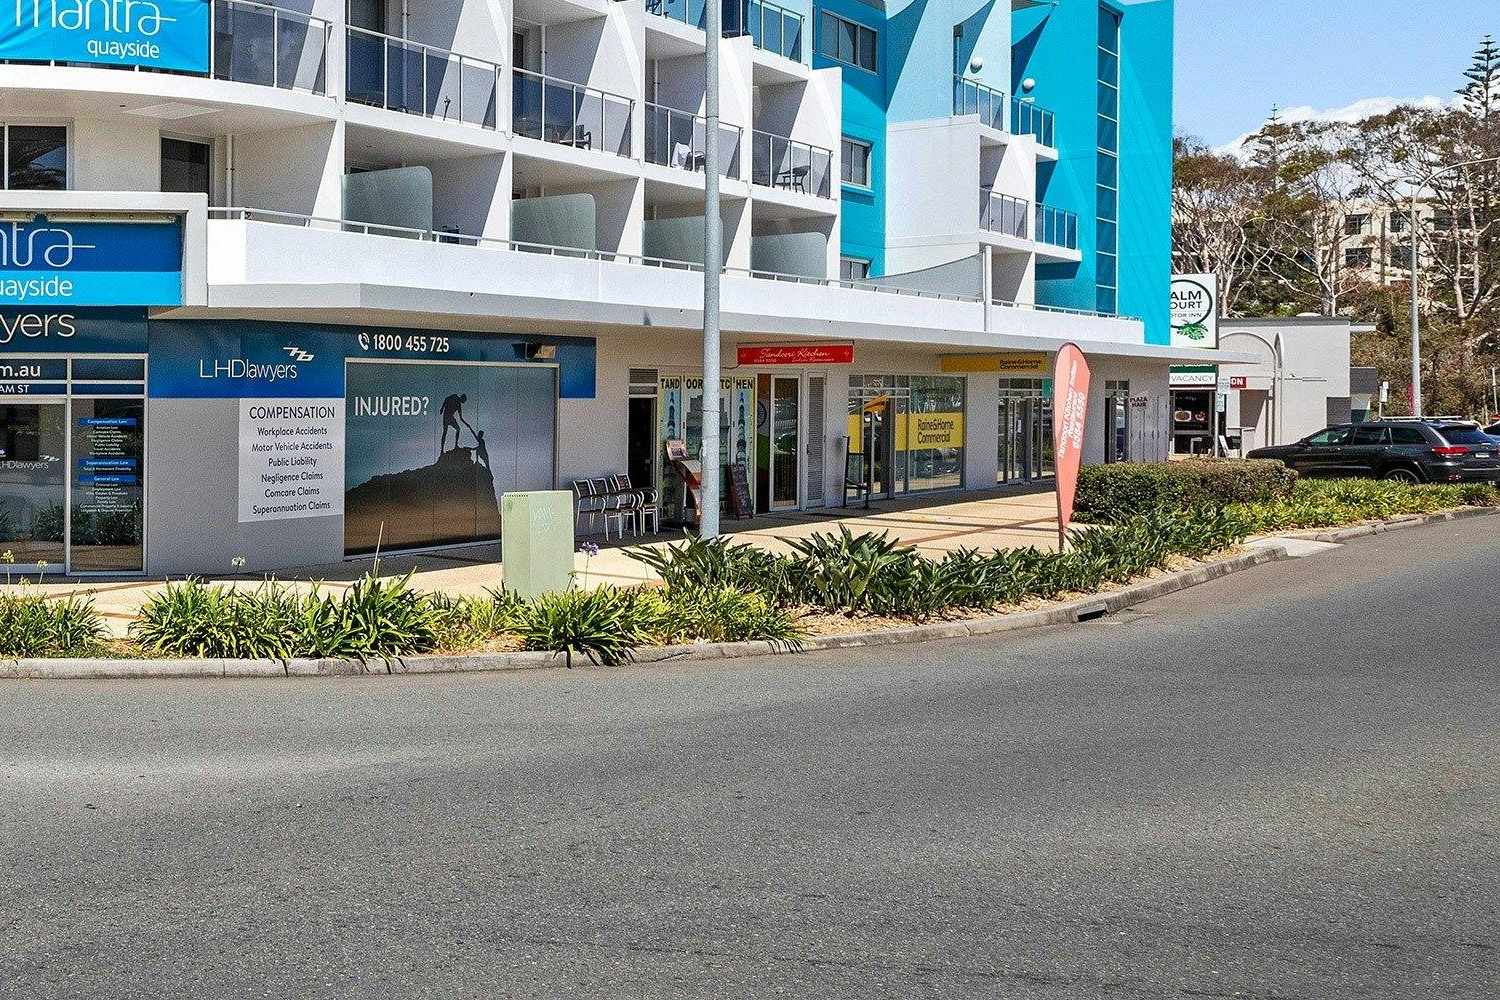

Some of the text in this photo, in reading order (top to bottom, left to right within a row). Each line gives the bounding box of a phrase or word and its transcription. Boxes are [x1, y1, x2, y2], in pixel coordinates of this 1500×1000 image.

[86, 38, 160, 60] quayside
[1170, 290, 1202, 300] ALM
[1170, 301, 1202, 310] OURT
[373, 334, 450, 353] 1800 455 725
[797, 348, 830, 358] Kitchen
[200, 359, 298, 382] LHDlawyers
[16, 384, 30, 394] ST
[354, 396, 429, 416] INJURED?
[249, 406, 335, 420] COMPENSATION
[257, 426, 328, 438] Workplace Accidents
[918, 431, 951, 444] Commercial
[251, 442, 333, 452] Motor Vehicle Accidents
[268, 456, 317, 467] Public Liability
[261, 471, 324, 484] Negligence Claims
[264, 487, 320, 498] Comcare Claims
[252, 500, 331, 516] Superannuation Claims
